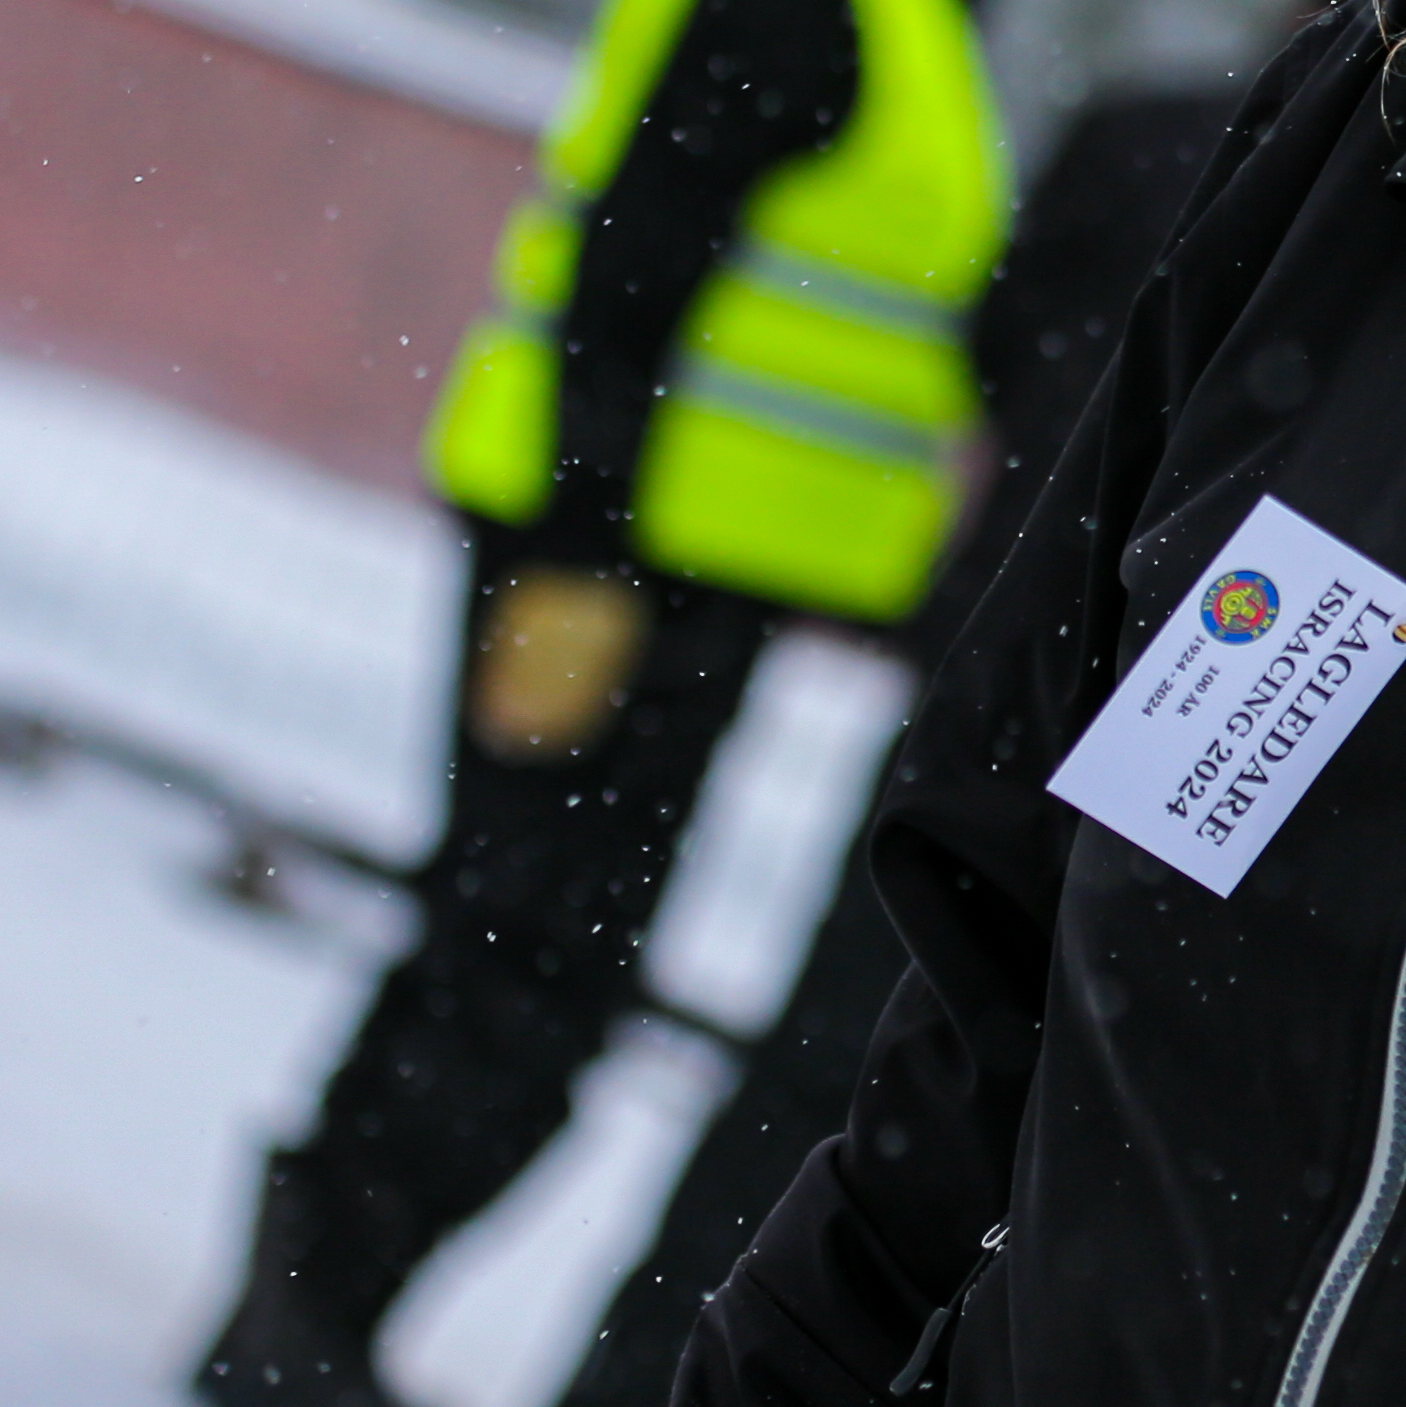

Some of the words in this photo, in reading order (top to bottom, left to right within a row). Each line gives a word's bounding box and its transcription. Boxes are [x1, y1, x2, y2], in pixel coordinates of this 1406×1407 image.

[1175, 636, 1206, 671] 1924
[1224, 578, 1358, 739] ISRACING
[1141, 679, 1173, 717] 2024
[1195, 666, 1220, 693] 100
[1176, 692, 1201, 716] ÅR
[1195, 599, 1395, 848] LAGLEDARE
[1165, 738, 1234, 821] 2024
